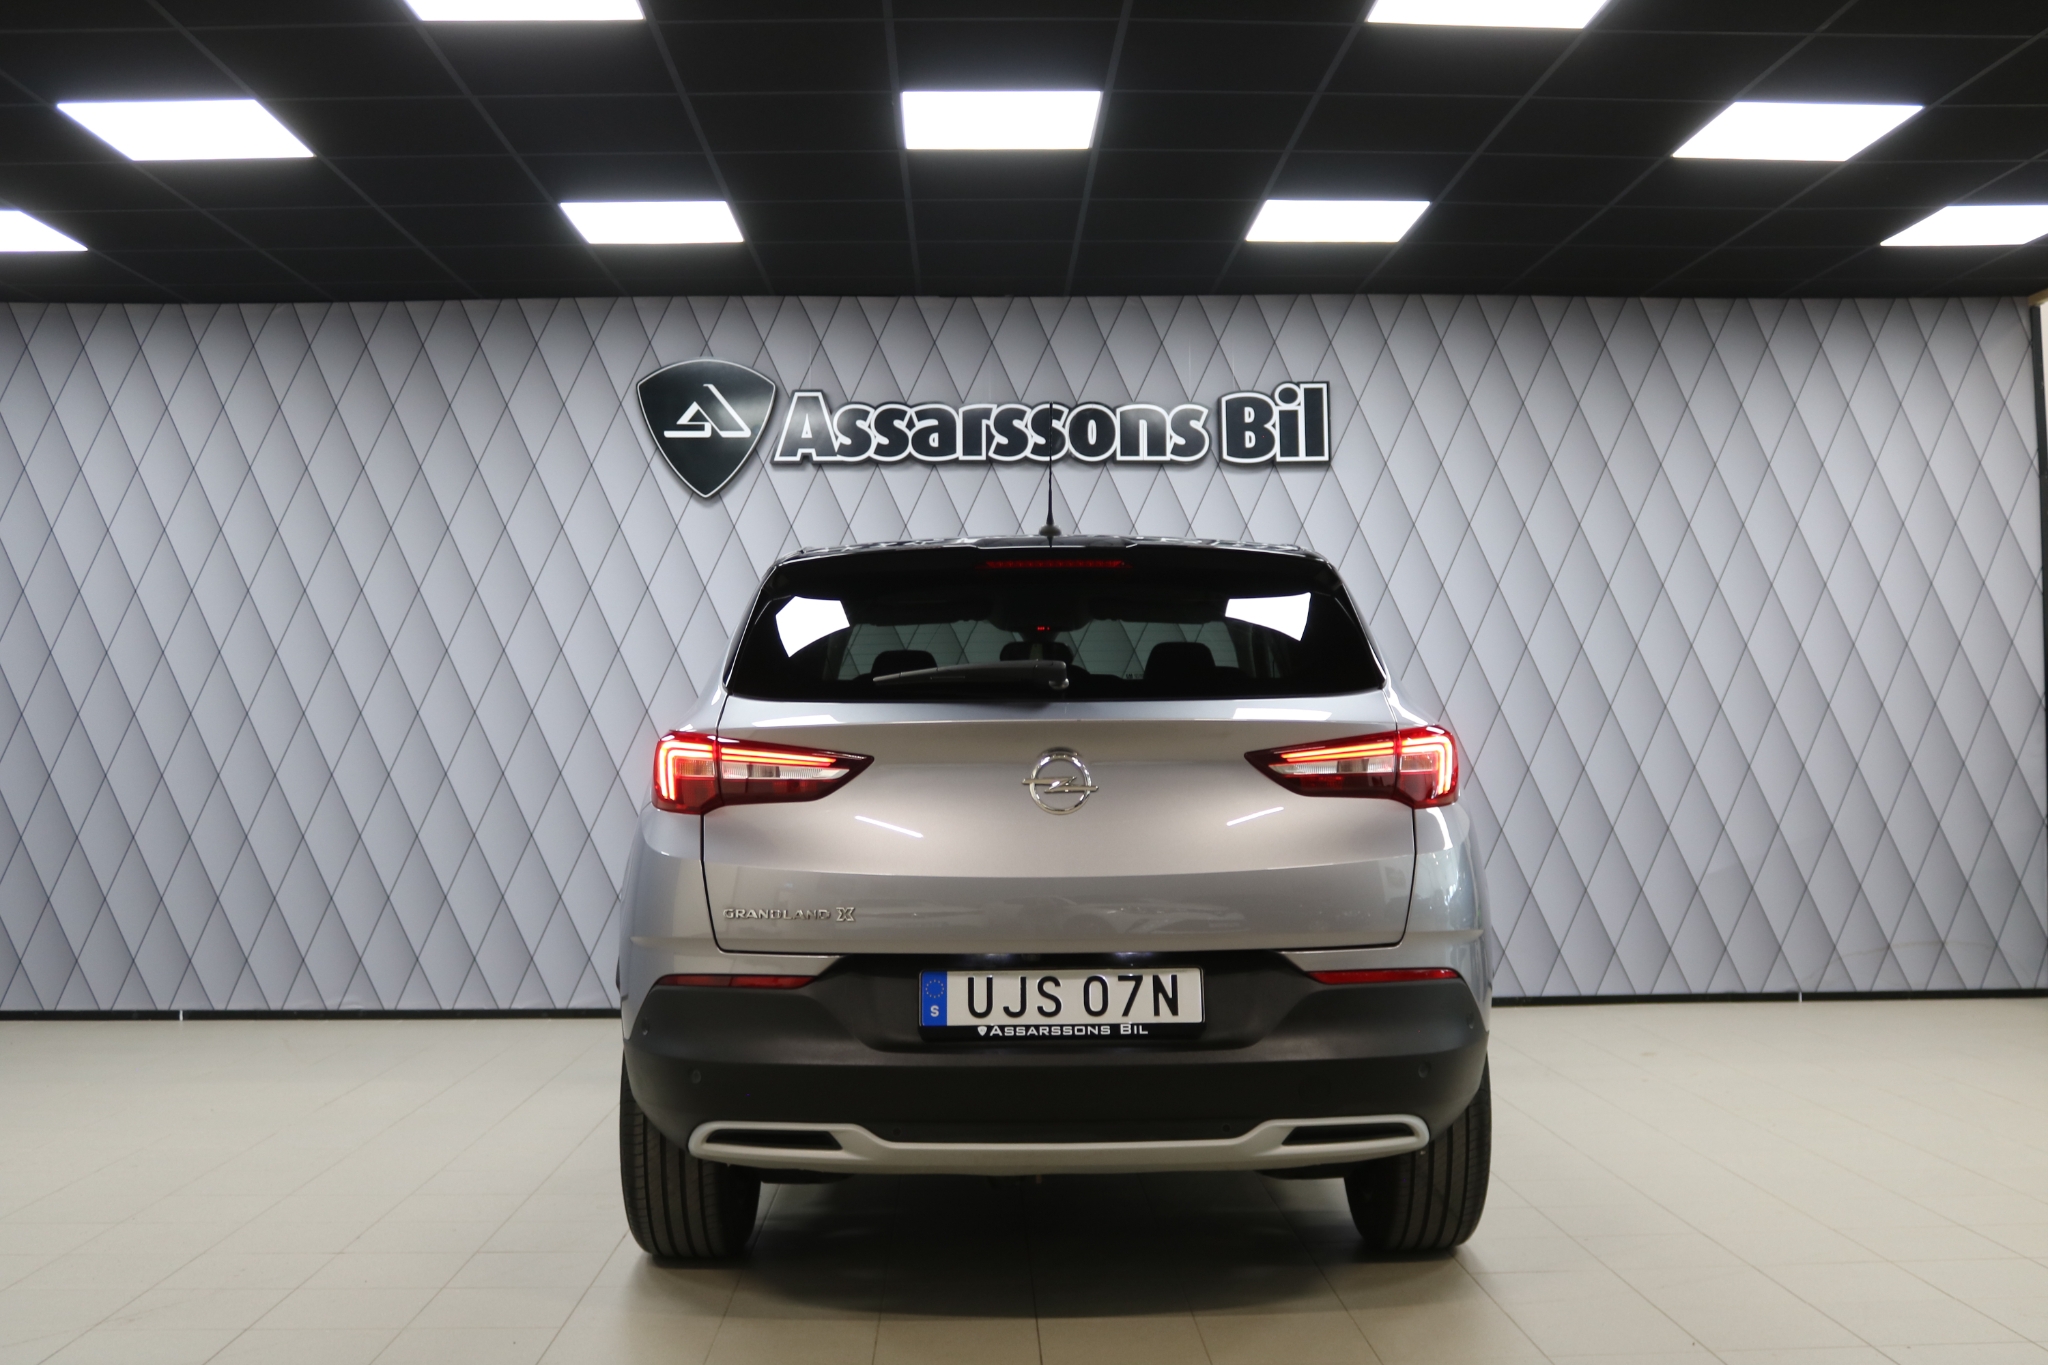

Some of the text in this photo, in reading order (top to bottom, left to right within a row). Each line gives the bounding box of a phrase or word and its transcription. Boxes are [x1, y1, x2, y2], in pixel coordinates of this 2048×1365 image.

[772, 382, 1330, 463] Assarssons Bil
[723, 907, 855, 922] GRANDLAND X
[967, 974, 1179, 1018] UJS 07N
[930, 1005, 939, 1017] S
[990, 1024, 1148, 1036] ASSARSSONS BIL
